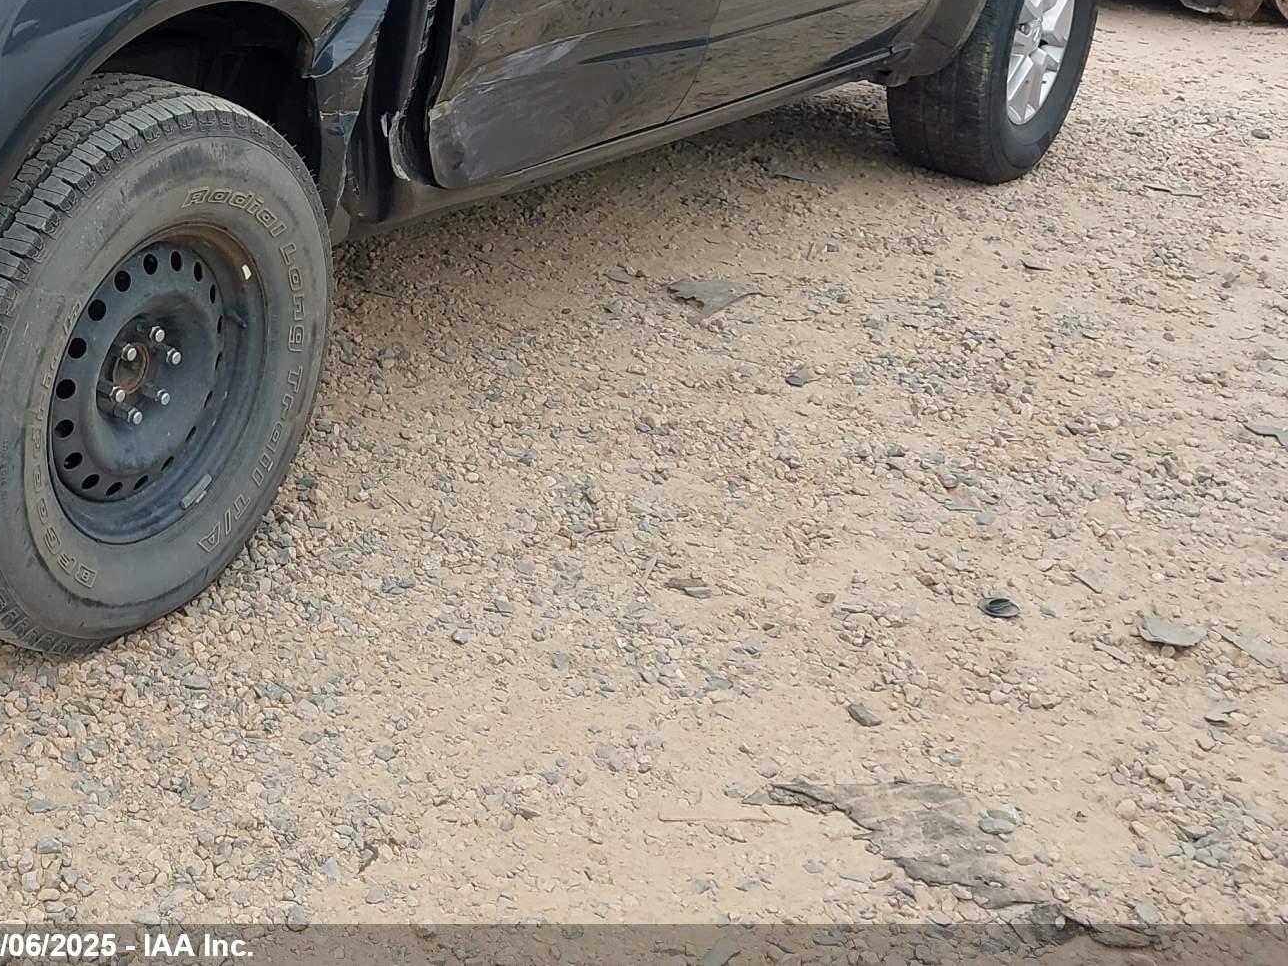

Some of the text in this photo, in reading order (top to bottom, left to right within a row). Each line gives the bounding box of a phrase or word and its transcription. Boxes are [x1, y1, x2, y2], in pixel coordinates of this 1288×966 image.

[181, 186, 306, 553] Radial Long Trail T/A
